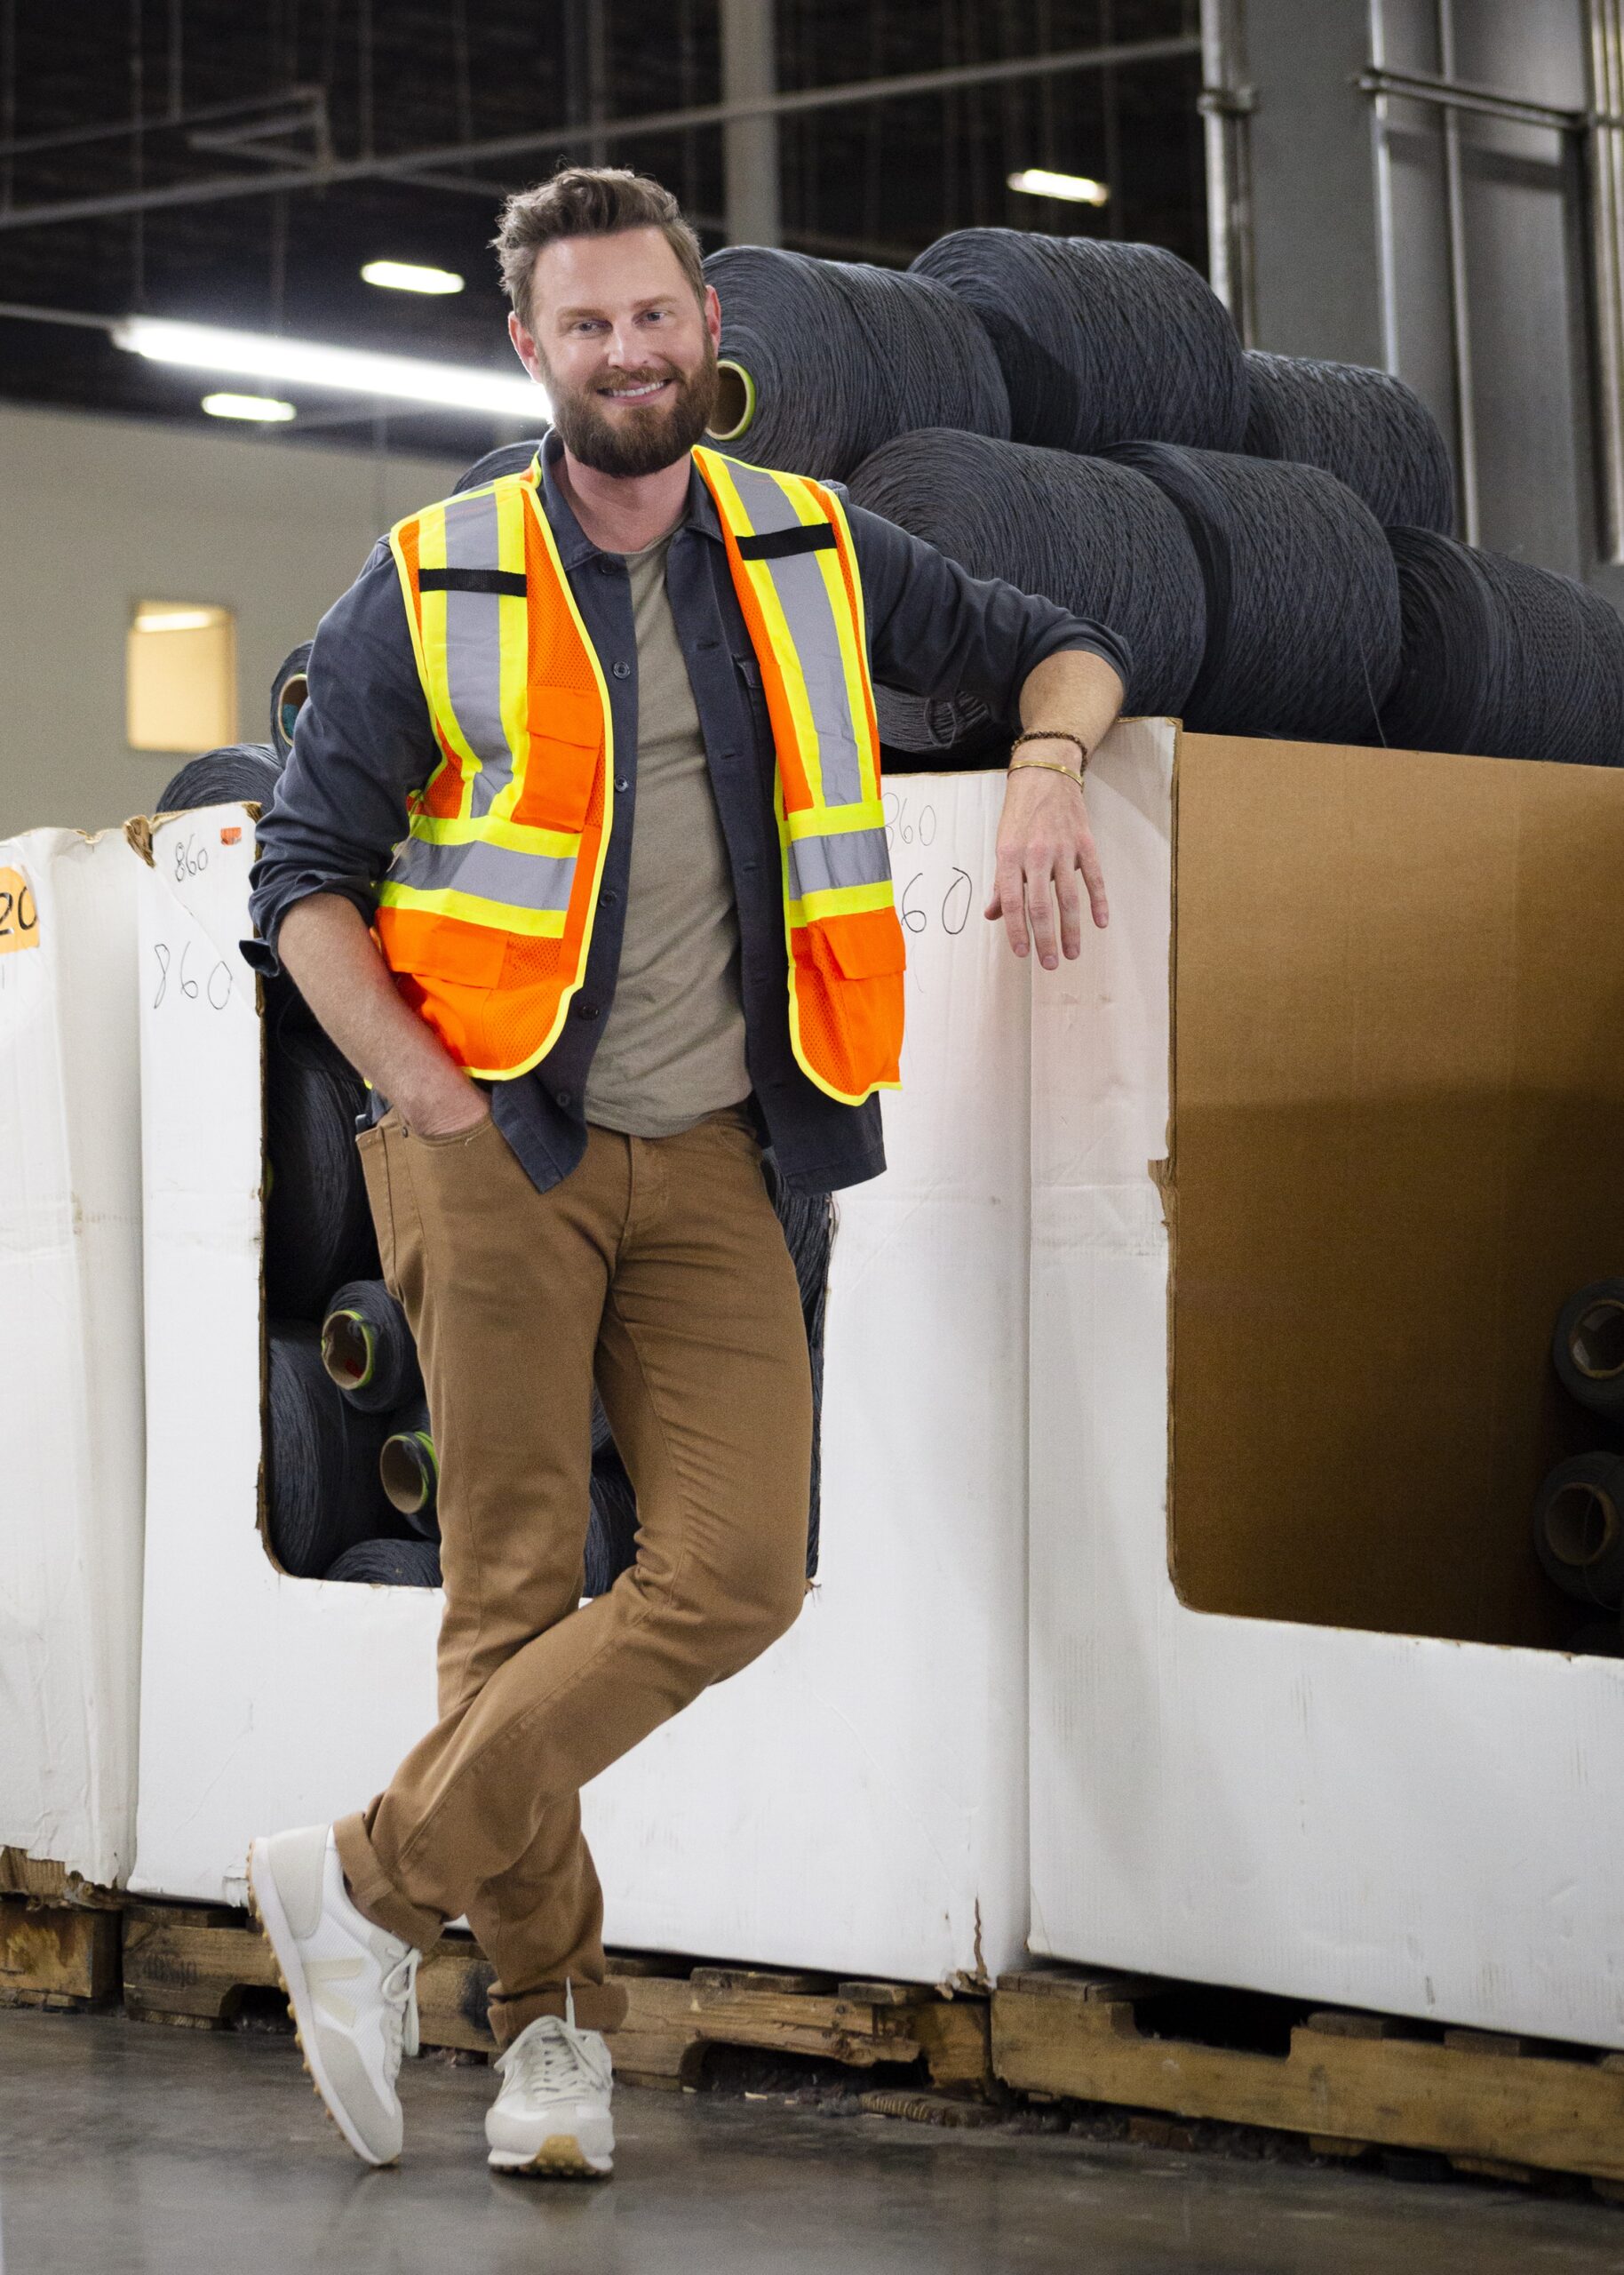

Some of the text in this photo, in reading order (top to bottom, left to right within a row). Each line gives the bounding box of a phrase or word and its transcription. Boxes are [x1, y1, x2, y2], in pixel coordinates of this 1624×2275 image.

[175, 834, 209, 882] 860
[901, 866, 973, 935] 60
[154, 940, 233, 1010] 860
